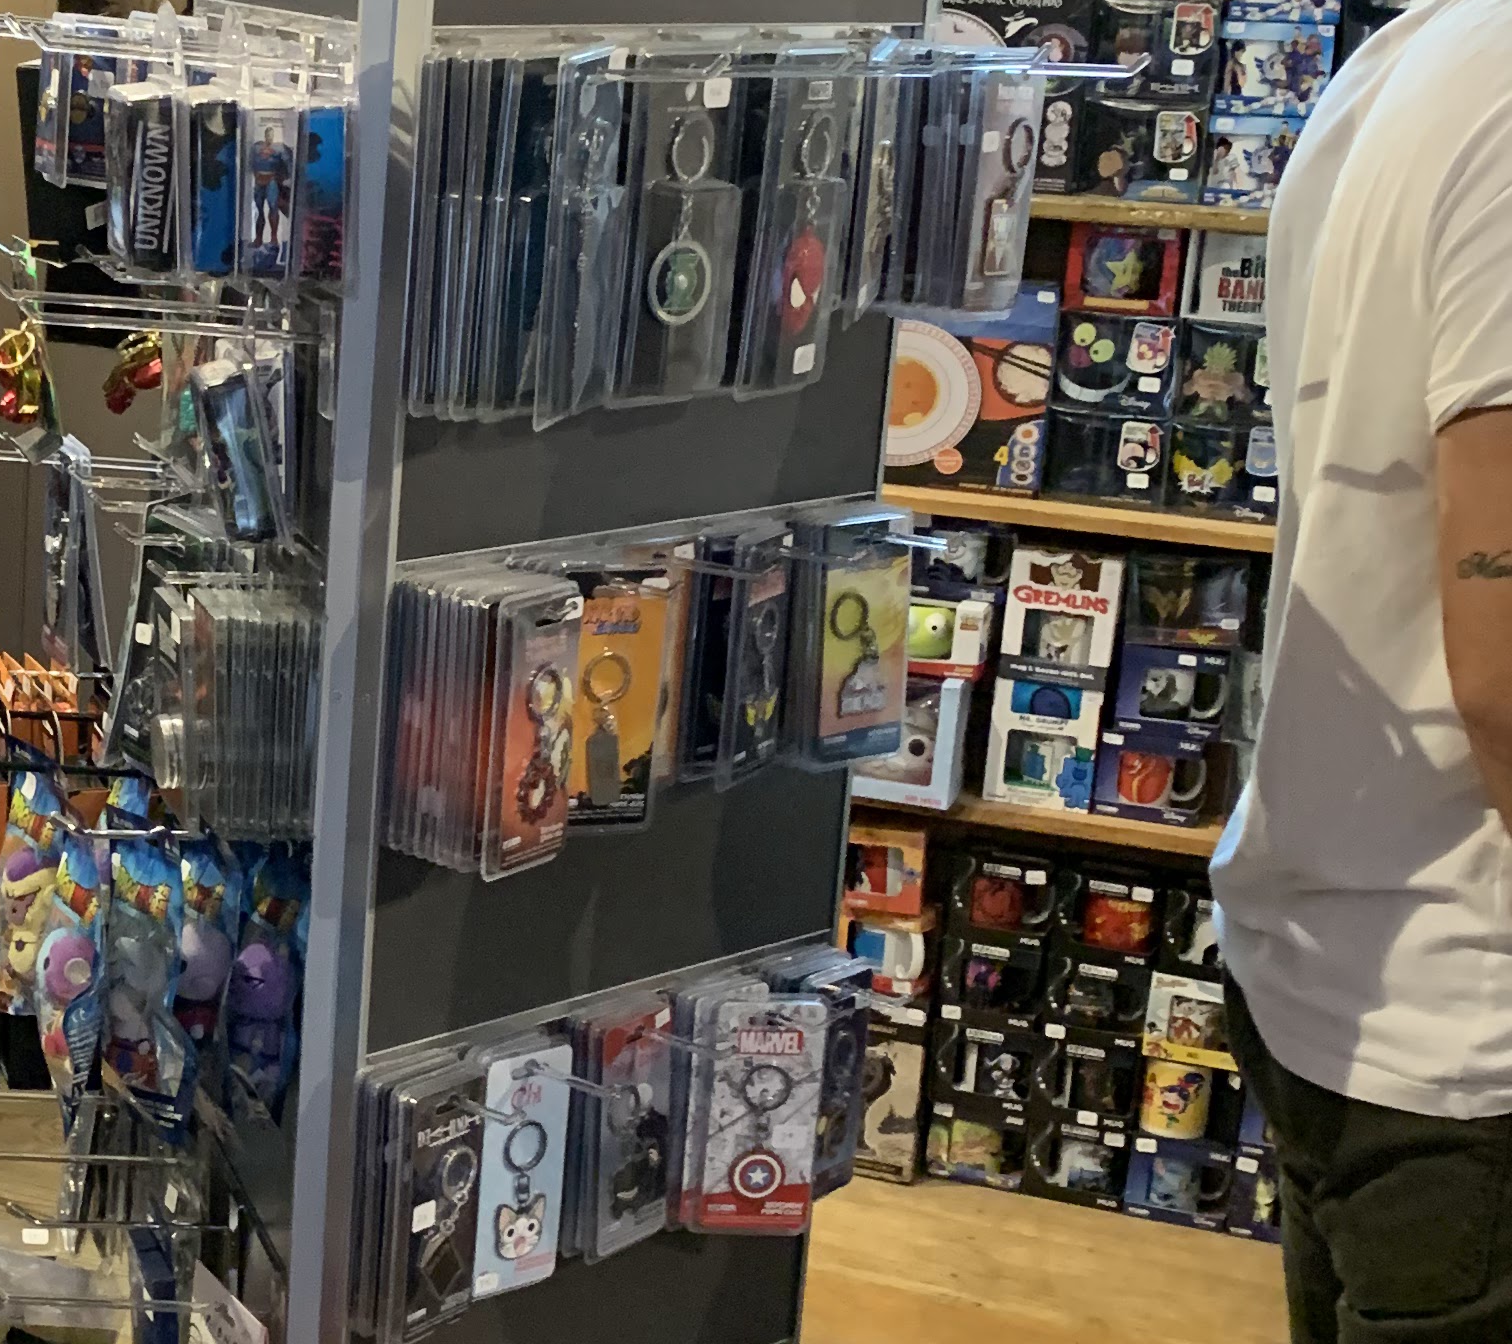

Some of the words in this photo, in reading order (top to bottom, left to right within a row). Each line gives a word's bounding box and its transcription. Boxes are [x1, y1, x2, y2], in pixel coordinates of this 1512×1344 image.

[135, 121, 172, 251] UNKNOWN
[1013, 584, 1110, 614] GREMLINS
[740, 1031, 802, 1053] MARVEL
